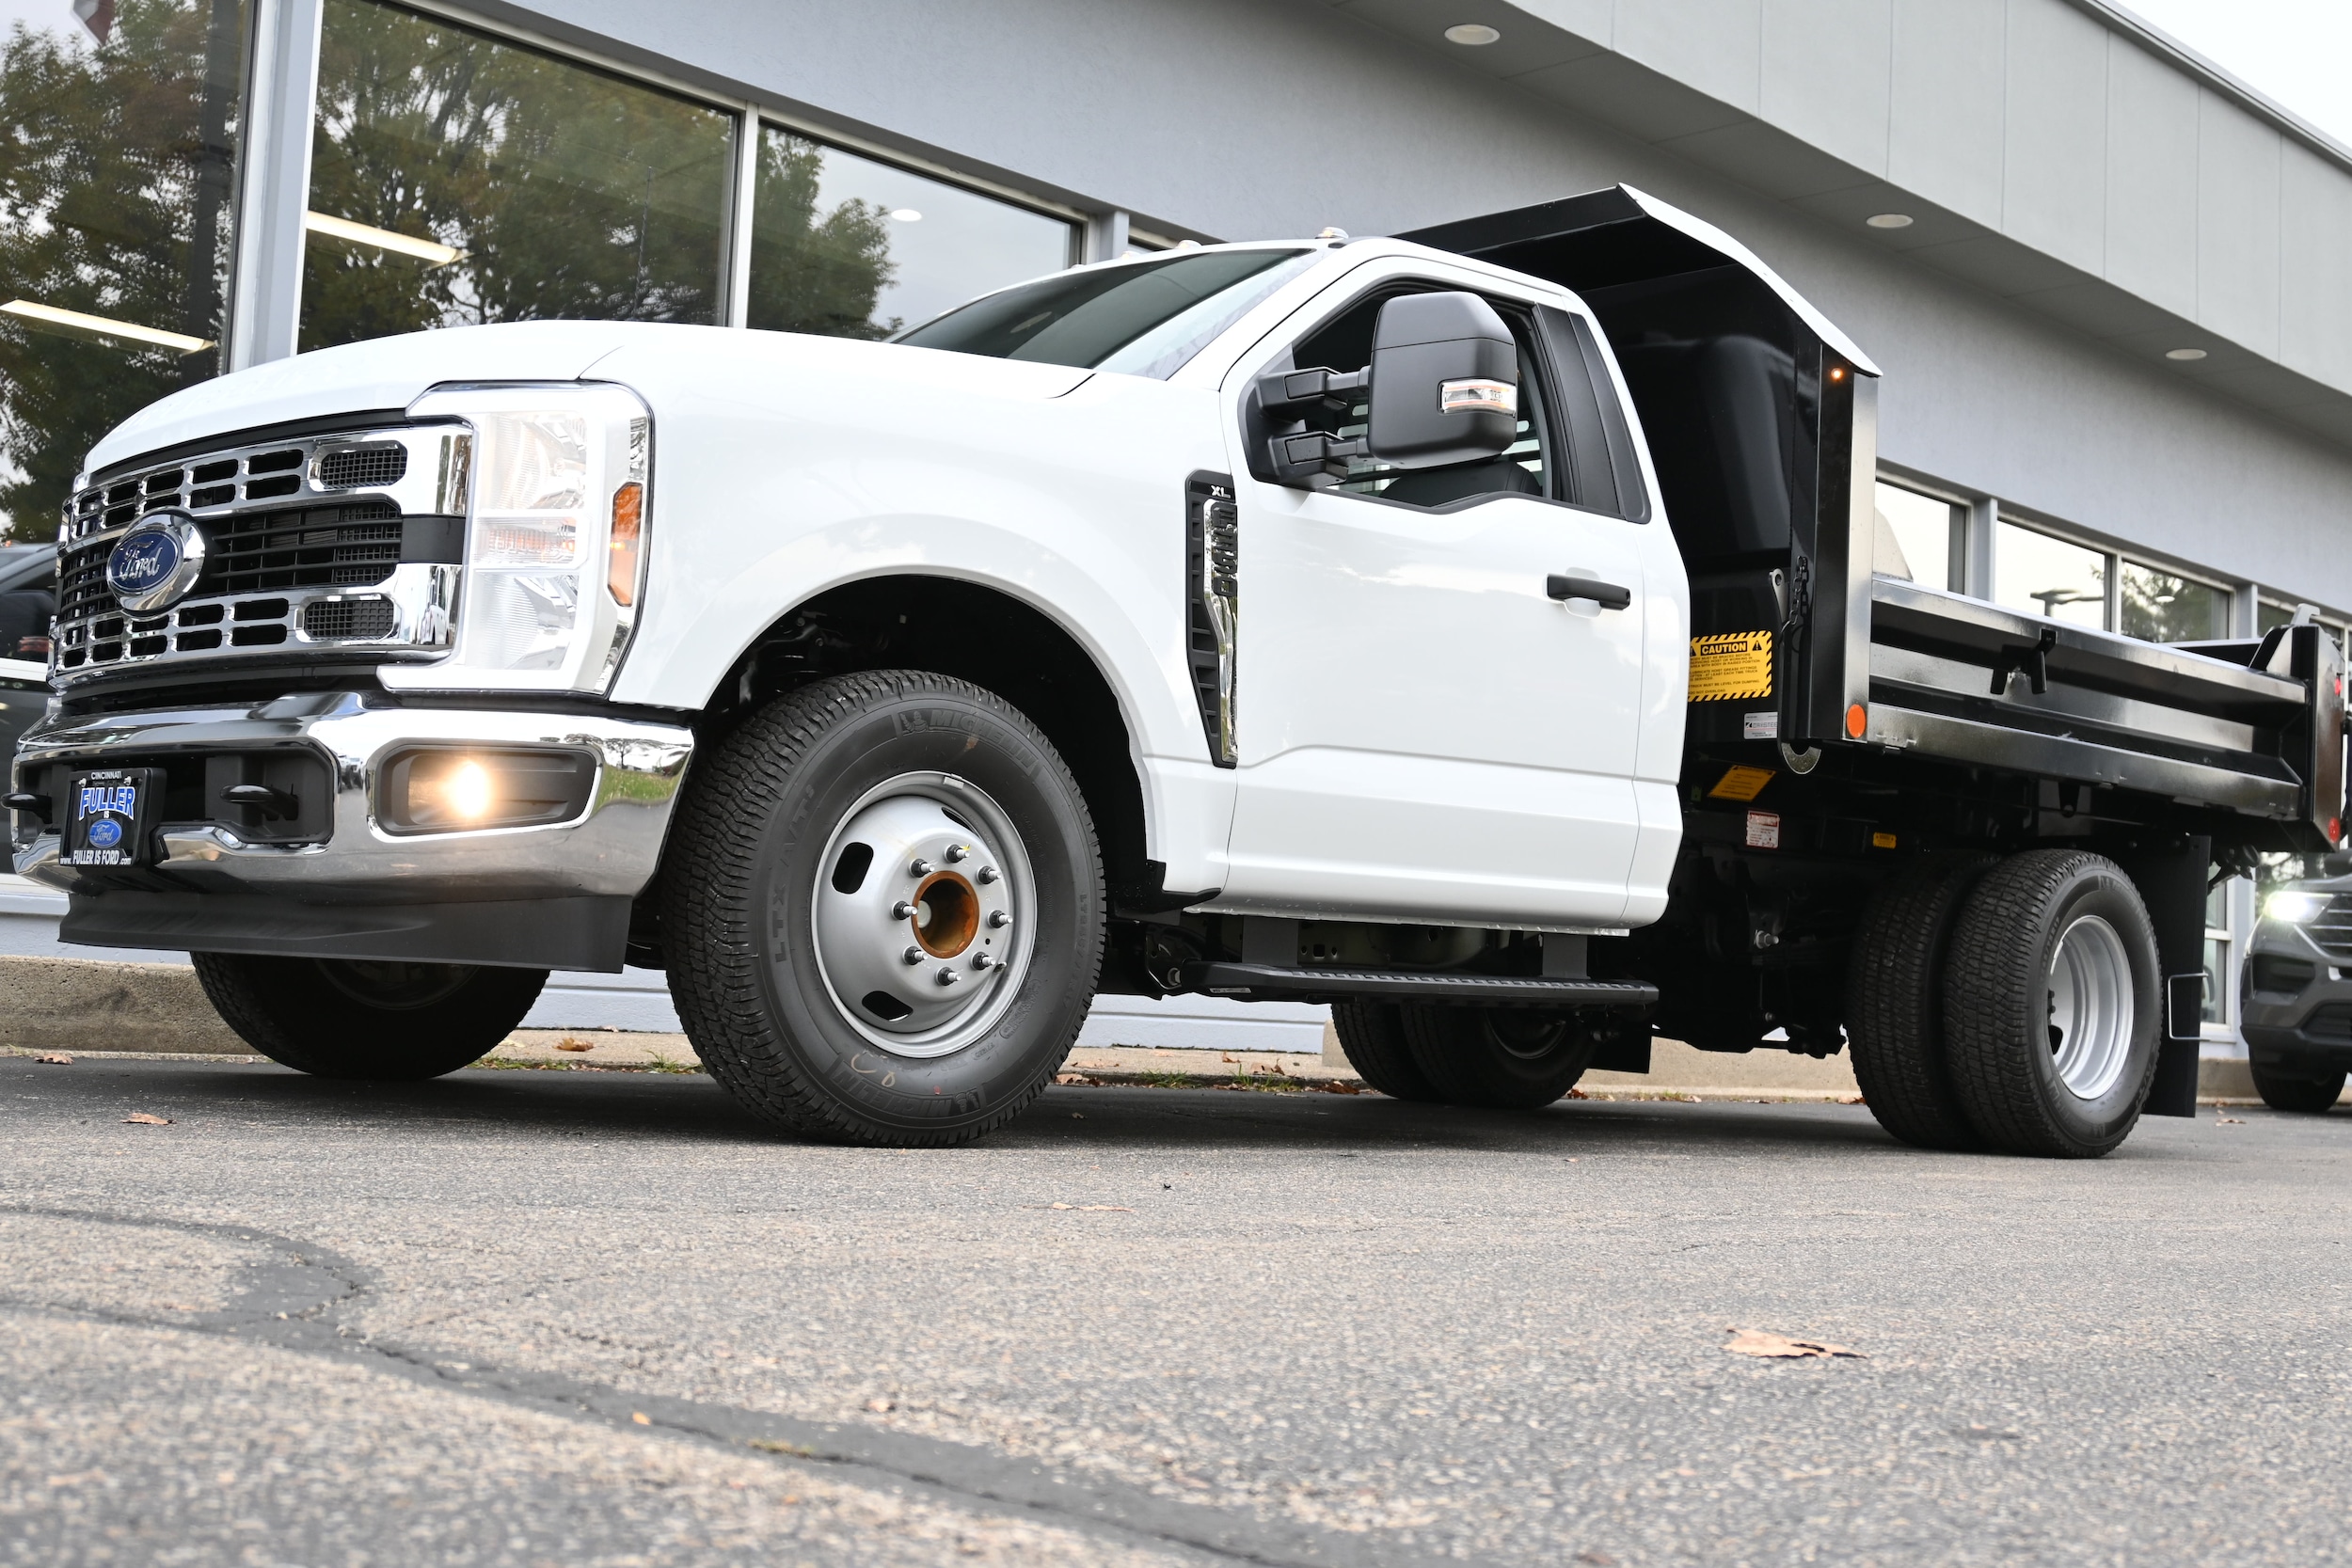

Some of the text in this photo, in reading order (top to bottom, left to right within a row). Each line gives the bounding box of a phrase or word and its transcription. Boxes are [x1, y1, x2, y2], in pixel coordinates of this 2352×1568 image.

[1211, 485, 1232, 499] XL
[117, 540, 164, 581] Ford
[1702, 642, 1746, 654] CAUTION
[930, 709, 1039, 769] MICHELIN
[91, 771, 122, 780] CINCINNATI
[79, 786, 135, 821] FULLER
[94, 824, 114, 841] Ford
[72, 849, 94, 865] FULLER
[94, 849, 102, 865] IS
[101, 849, 120, 865] FORD
[828, 1069, 952, 1117] MICHELIN
